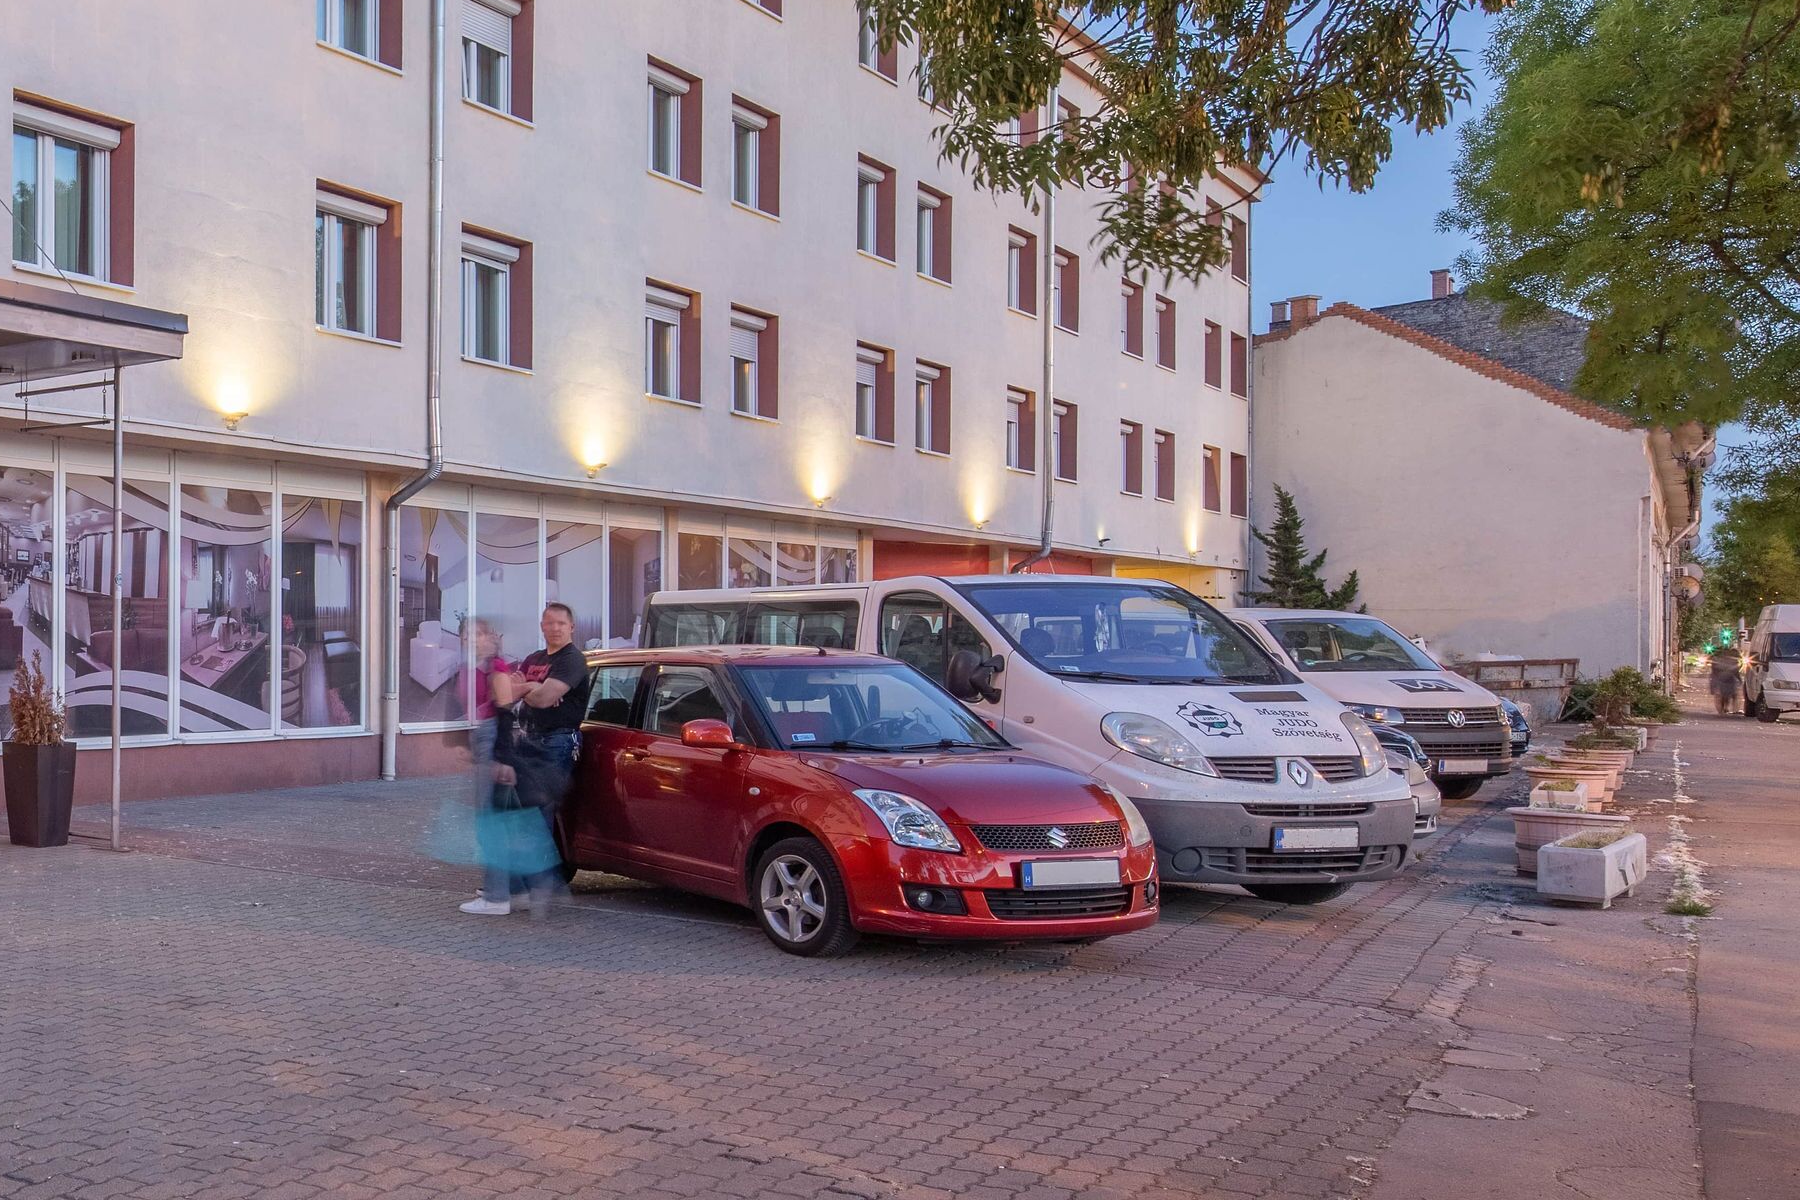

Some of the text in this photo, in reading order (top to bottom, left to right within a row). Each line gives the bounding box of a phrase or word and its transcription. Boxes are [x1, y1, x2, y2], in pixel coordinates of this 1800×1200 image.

[1254, 708, 1309, 718] Magyar
[1277, 718, 1318, 728] JUDO
[1272, 728, 1343, 742] Szövetség
[1025, 875, 1031, 883] H
